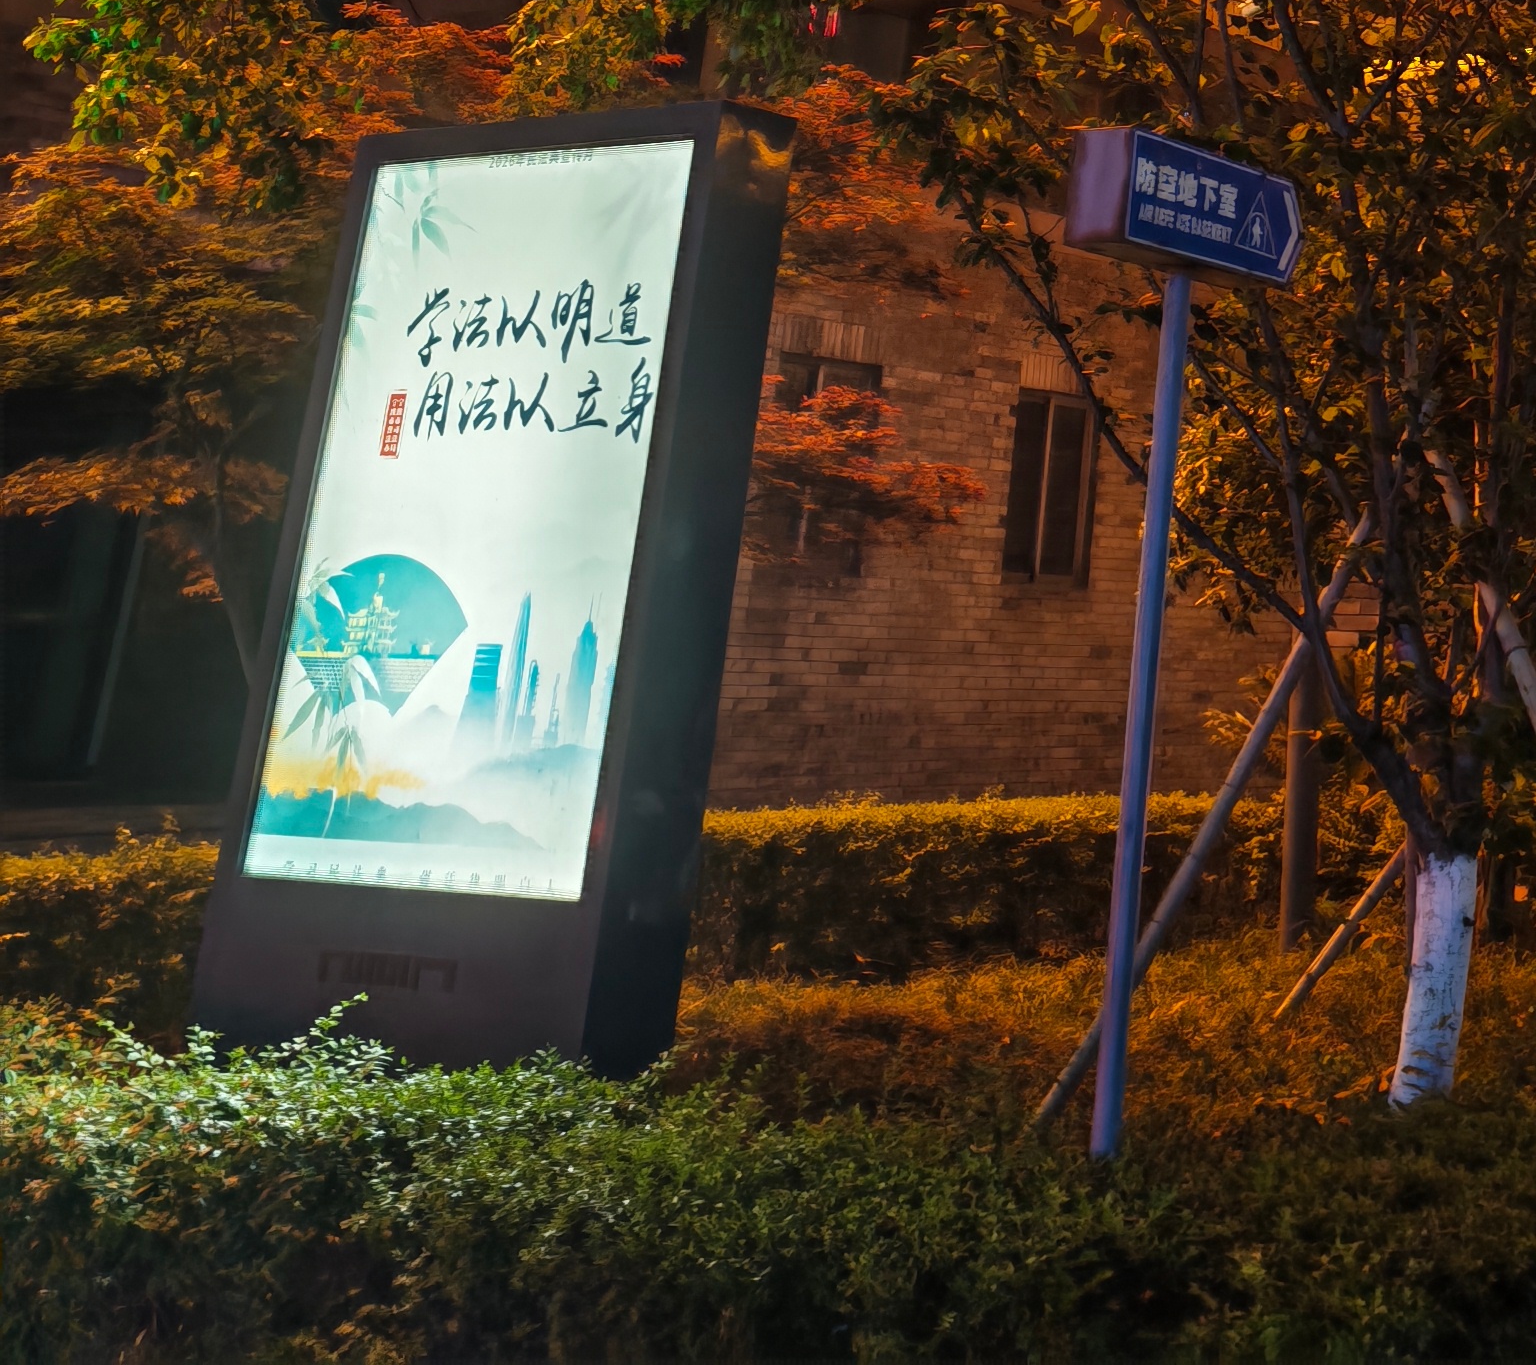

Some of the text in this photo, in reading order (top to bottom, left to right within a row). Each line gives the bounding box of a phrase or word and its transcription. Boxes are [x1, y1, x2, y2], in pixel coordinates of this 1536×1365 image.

[1135, 156, 1239, 220] 防空地下室
[406, 279, 652, 367] 学法以明道
[413, 357, 654, 444] 用法以立身
